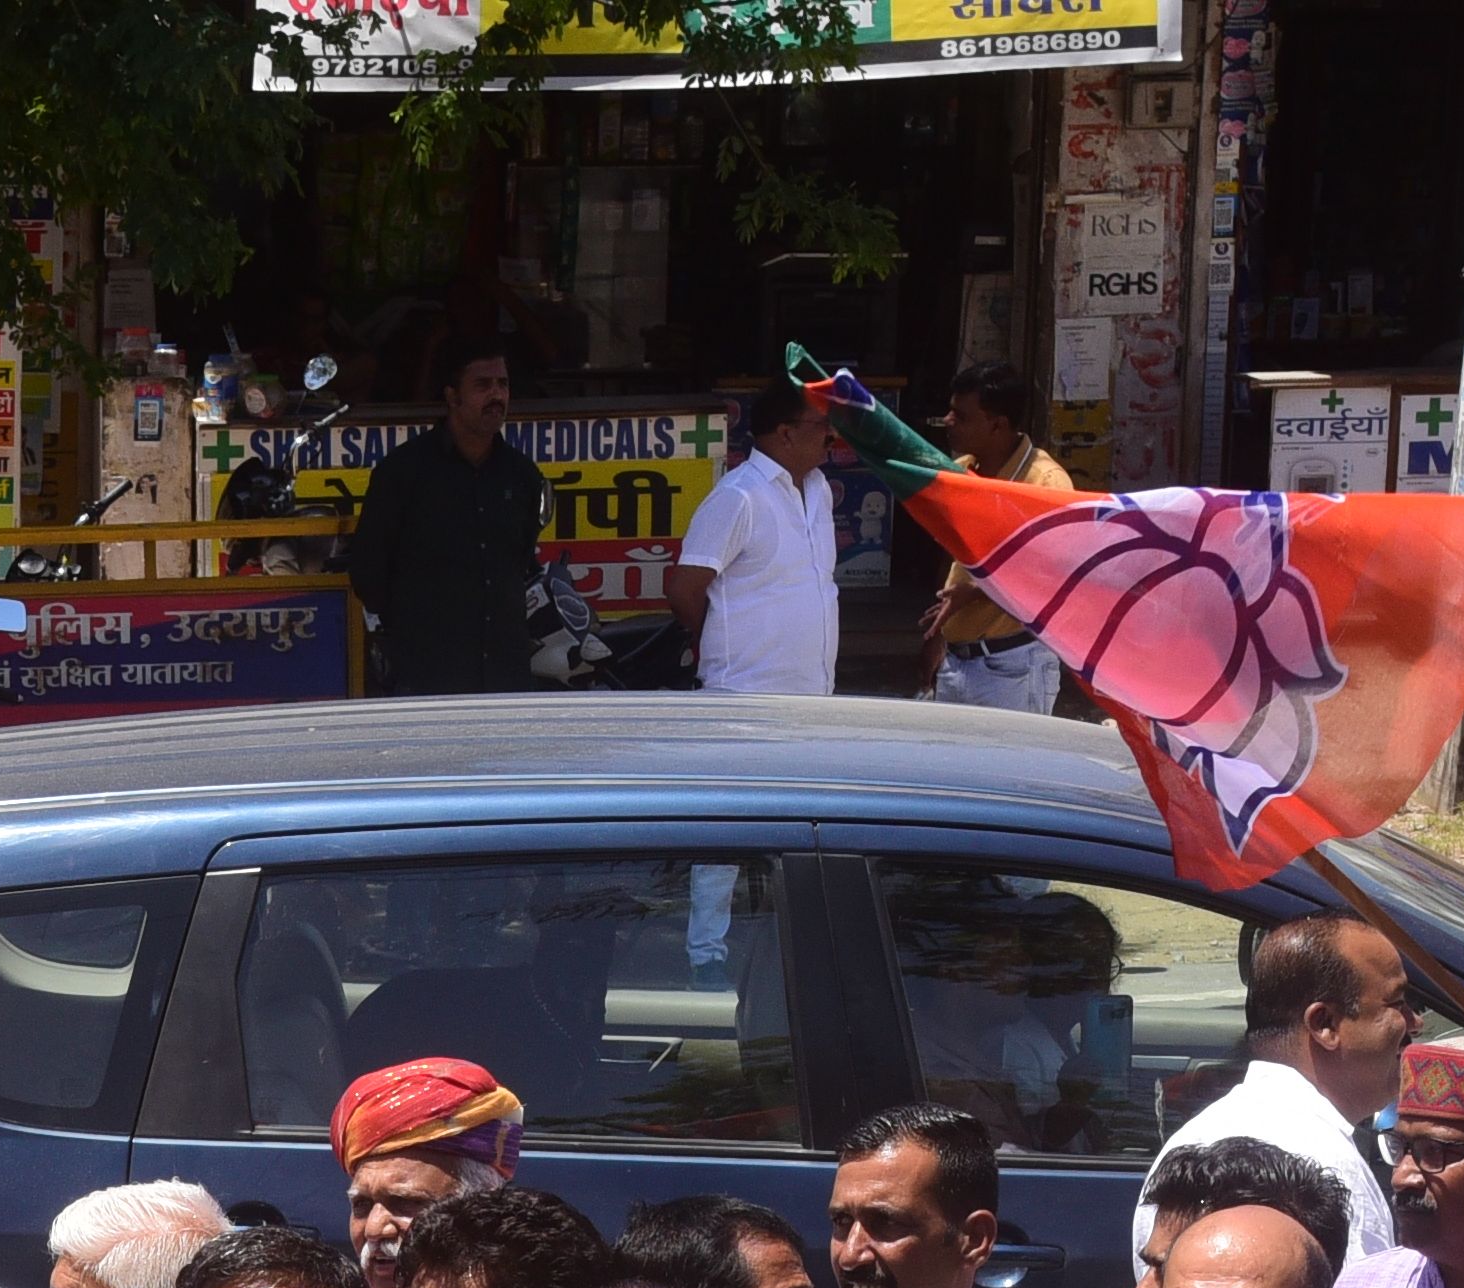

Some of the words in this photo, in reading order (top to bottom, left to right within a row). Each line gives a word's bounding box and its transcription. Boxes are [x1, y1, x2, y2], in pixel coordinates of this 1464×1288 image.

[940, 30, 1121, 57] 8619686890
[312, 58, 474, 80] 9782105
[1091, 212, 1157, 238] RGHS
[1088, 271, 1158, 298] RGHS
[1275, 407, 1389, 441] दवाईयाँ
[507, 417, 676, 462] MEDICALS
[164, 605, 319, 652] उदयपुर
[20, 658, 112, 696] सुरक्षित
[122, 660, 235, 686] यातायात
